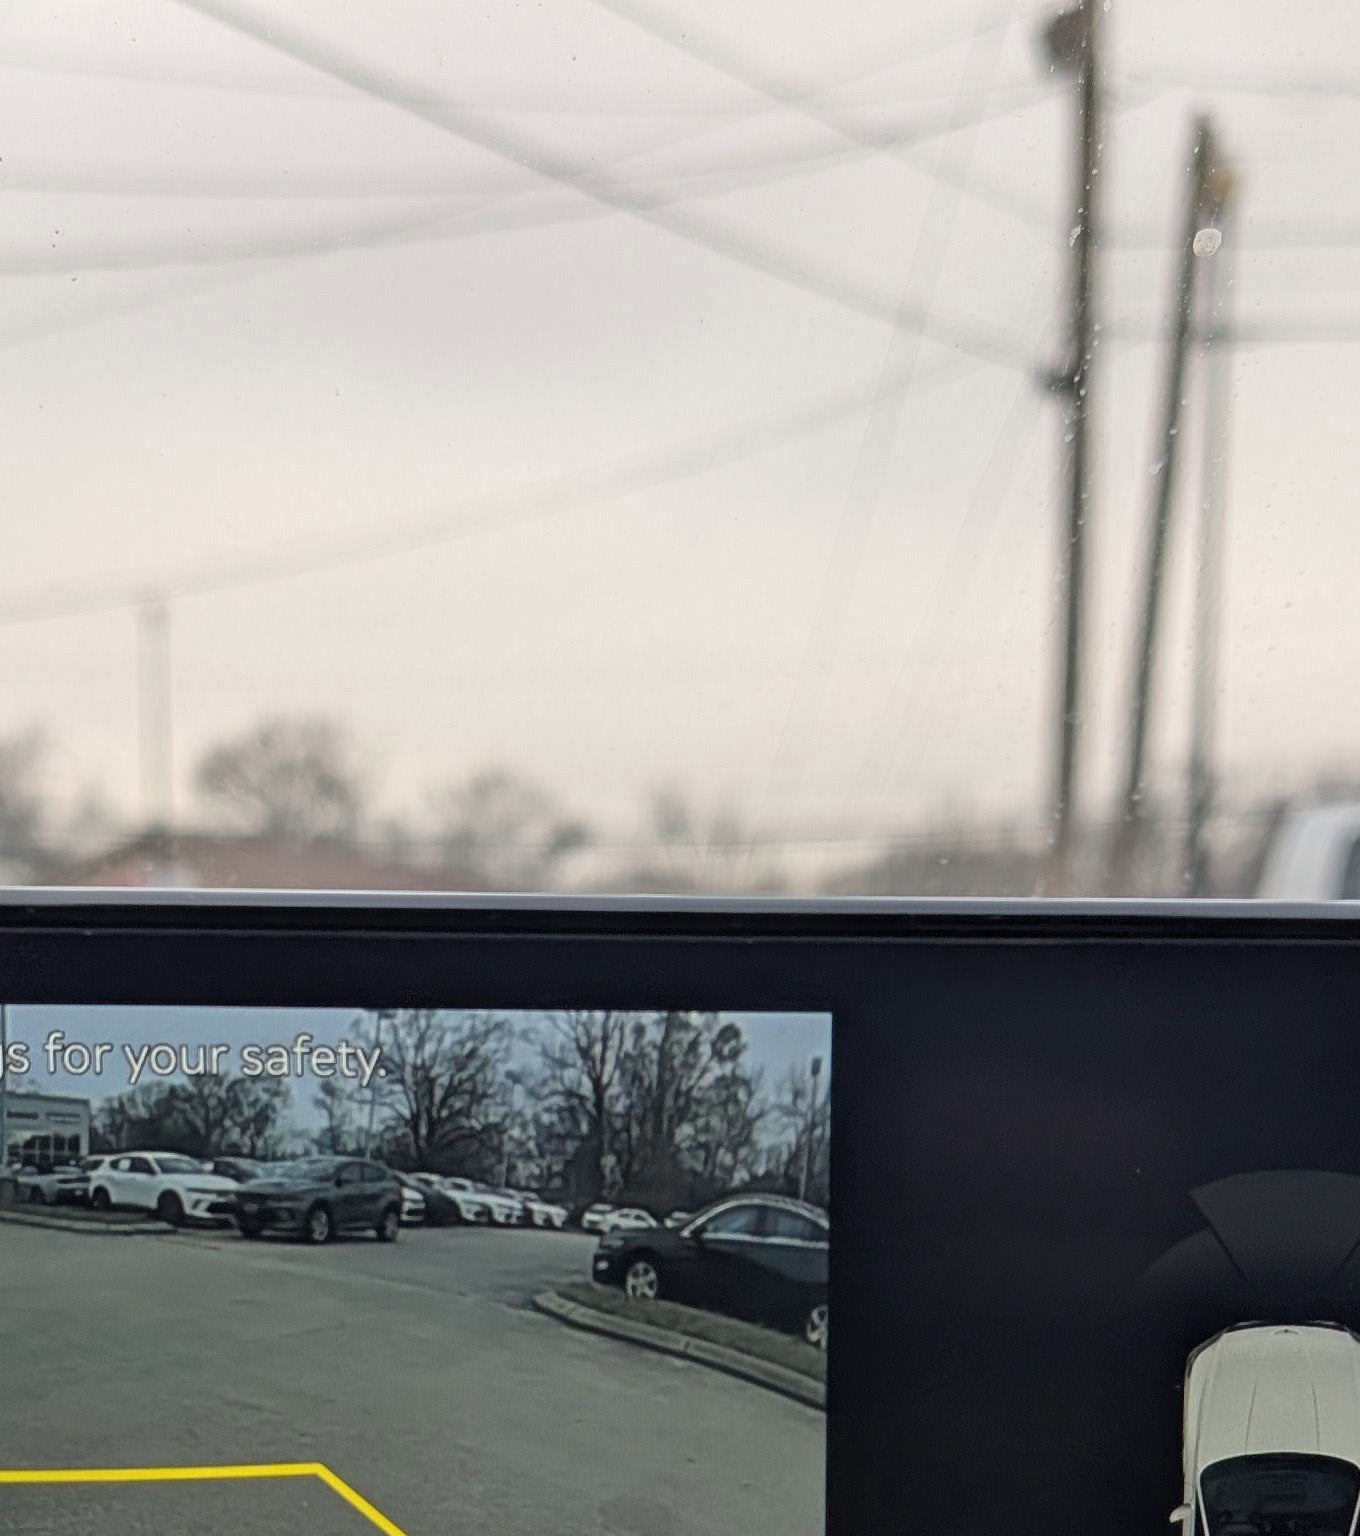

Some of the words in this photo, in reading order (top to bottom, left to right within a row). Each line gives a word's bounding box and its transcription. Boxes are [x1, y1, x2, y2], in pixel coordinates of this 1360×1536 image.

[45, 1031, 112, 1076] for
[122, 1043, 229, 1085] your
[241, 1034, 388, 1087] safety.
